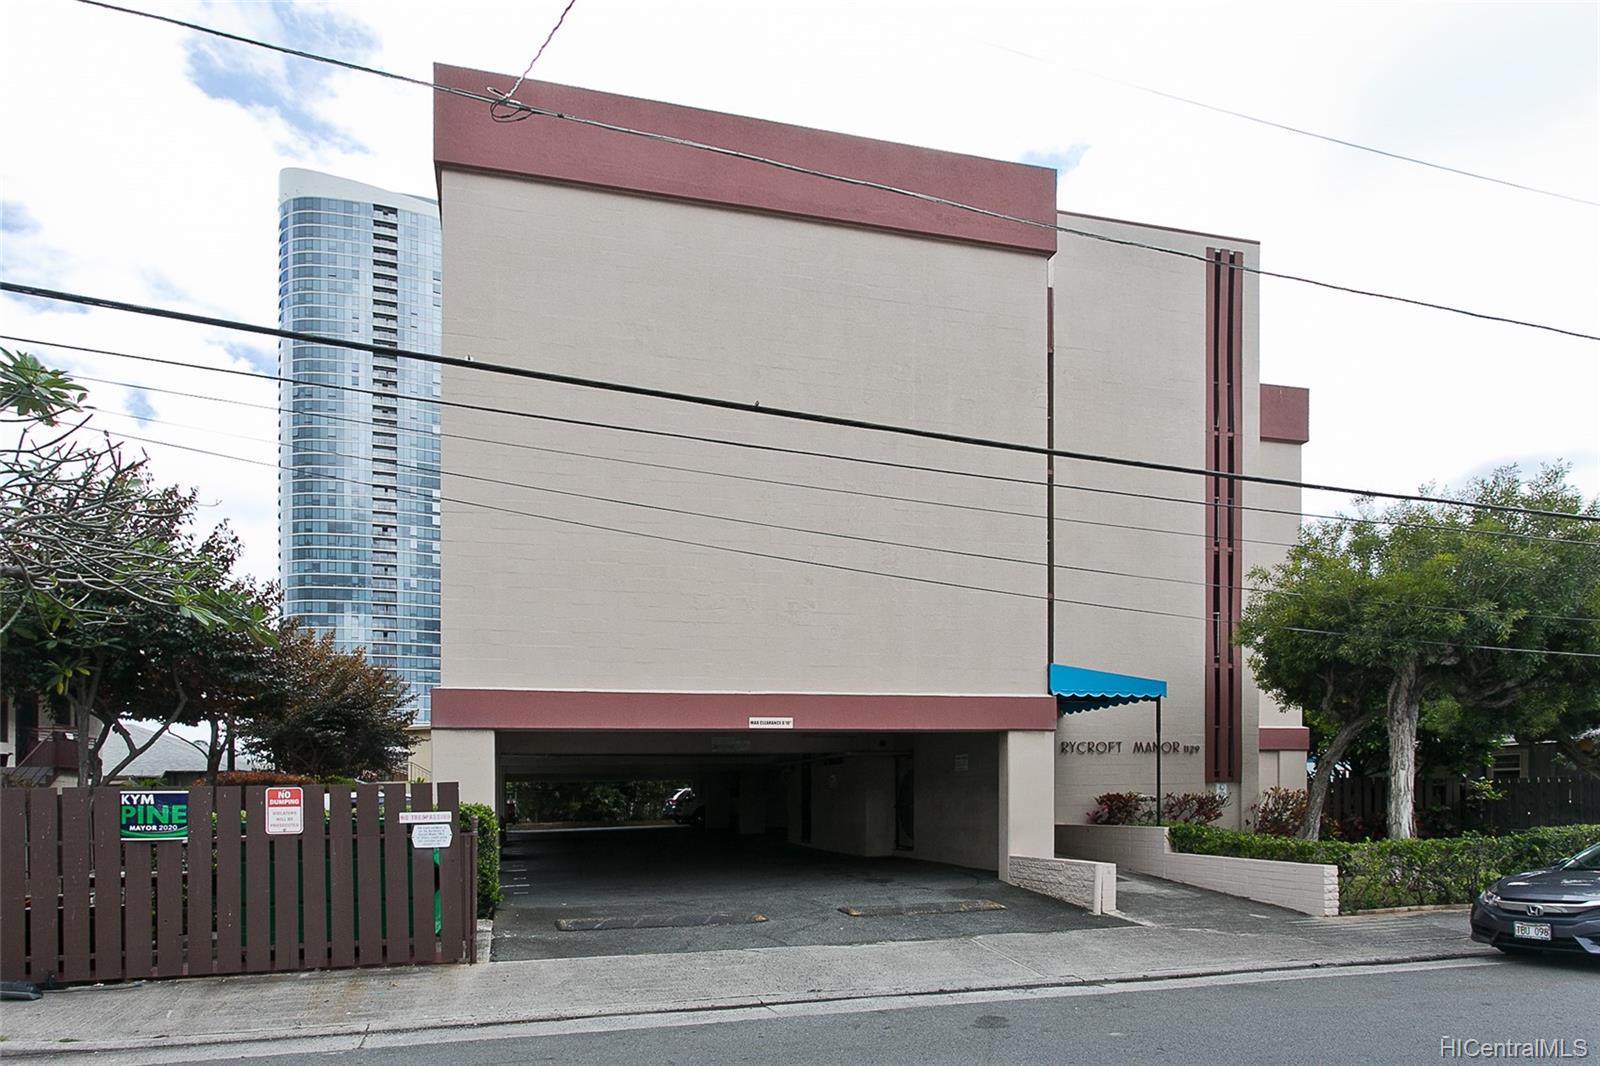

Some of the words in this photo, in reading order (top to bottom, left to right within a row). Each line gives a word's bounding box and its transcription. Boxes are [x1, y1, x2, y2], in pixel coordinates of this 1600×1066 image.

[1060, 741, 1122, 754] RYCROFT
[1133, 741, 1180, 754] MANOR
[121, 794, 154, 805] KYM
[278, 791, 291, 799] NO
[121, 804, 187, 824] PINE
[1516, 925, 1530, 935] TBU
[1535, 927, 1549, 936] 098
